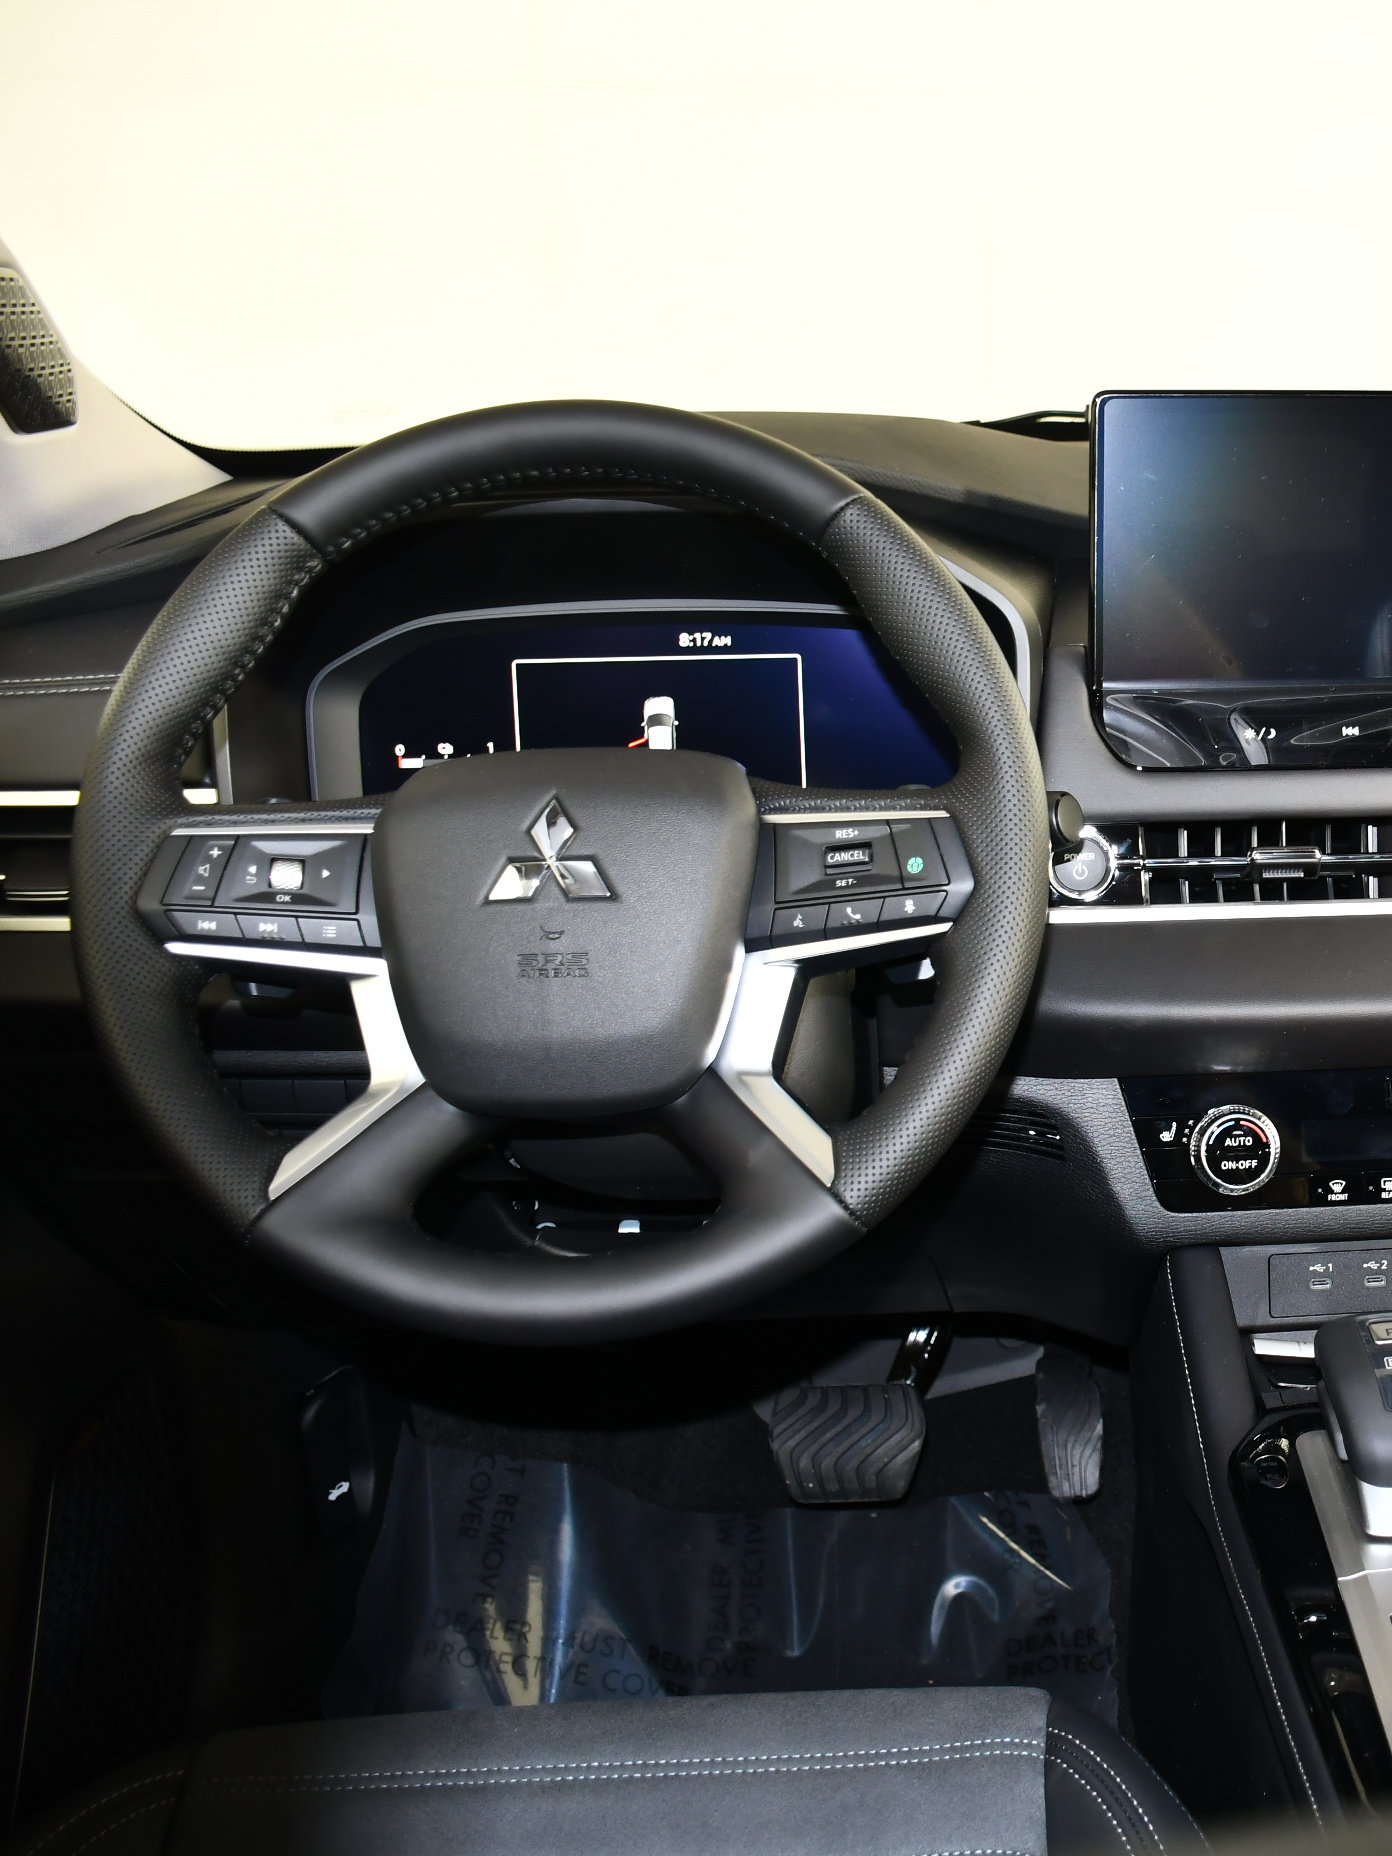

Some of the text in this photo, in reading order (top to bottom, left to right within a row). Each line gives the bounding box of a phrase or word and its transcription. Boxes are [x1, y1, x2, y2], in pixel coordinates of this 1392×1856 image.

[827, 850, 866, 863] CANCEL
[1064, 852, 1096, 861] POWER
[516, 952, 590, 967] SRS
[516, 967, 590, 980] AIRBAG
[1224, 1136, 1253, 1147] AUTO
[1327, 1193, 1349, 1201] FRONT
[459, 1453, 496, 1540] COVER
[473, 1492, 519, 1605] REMOVE
[433, 1607, 532, 1643] DEALER
[647, 1643, 757, 1679] REMOVE
[1006, 1626, 1100, 1658] DEALER
